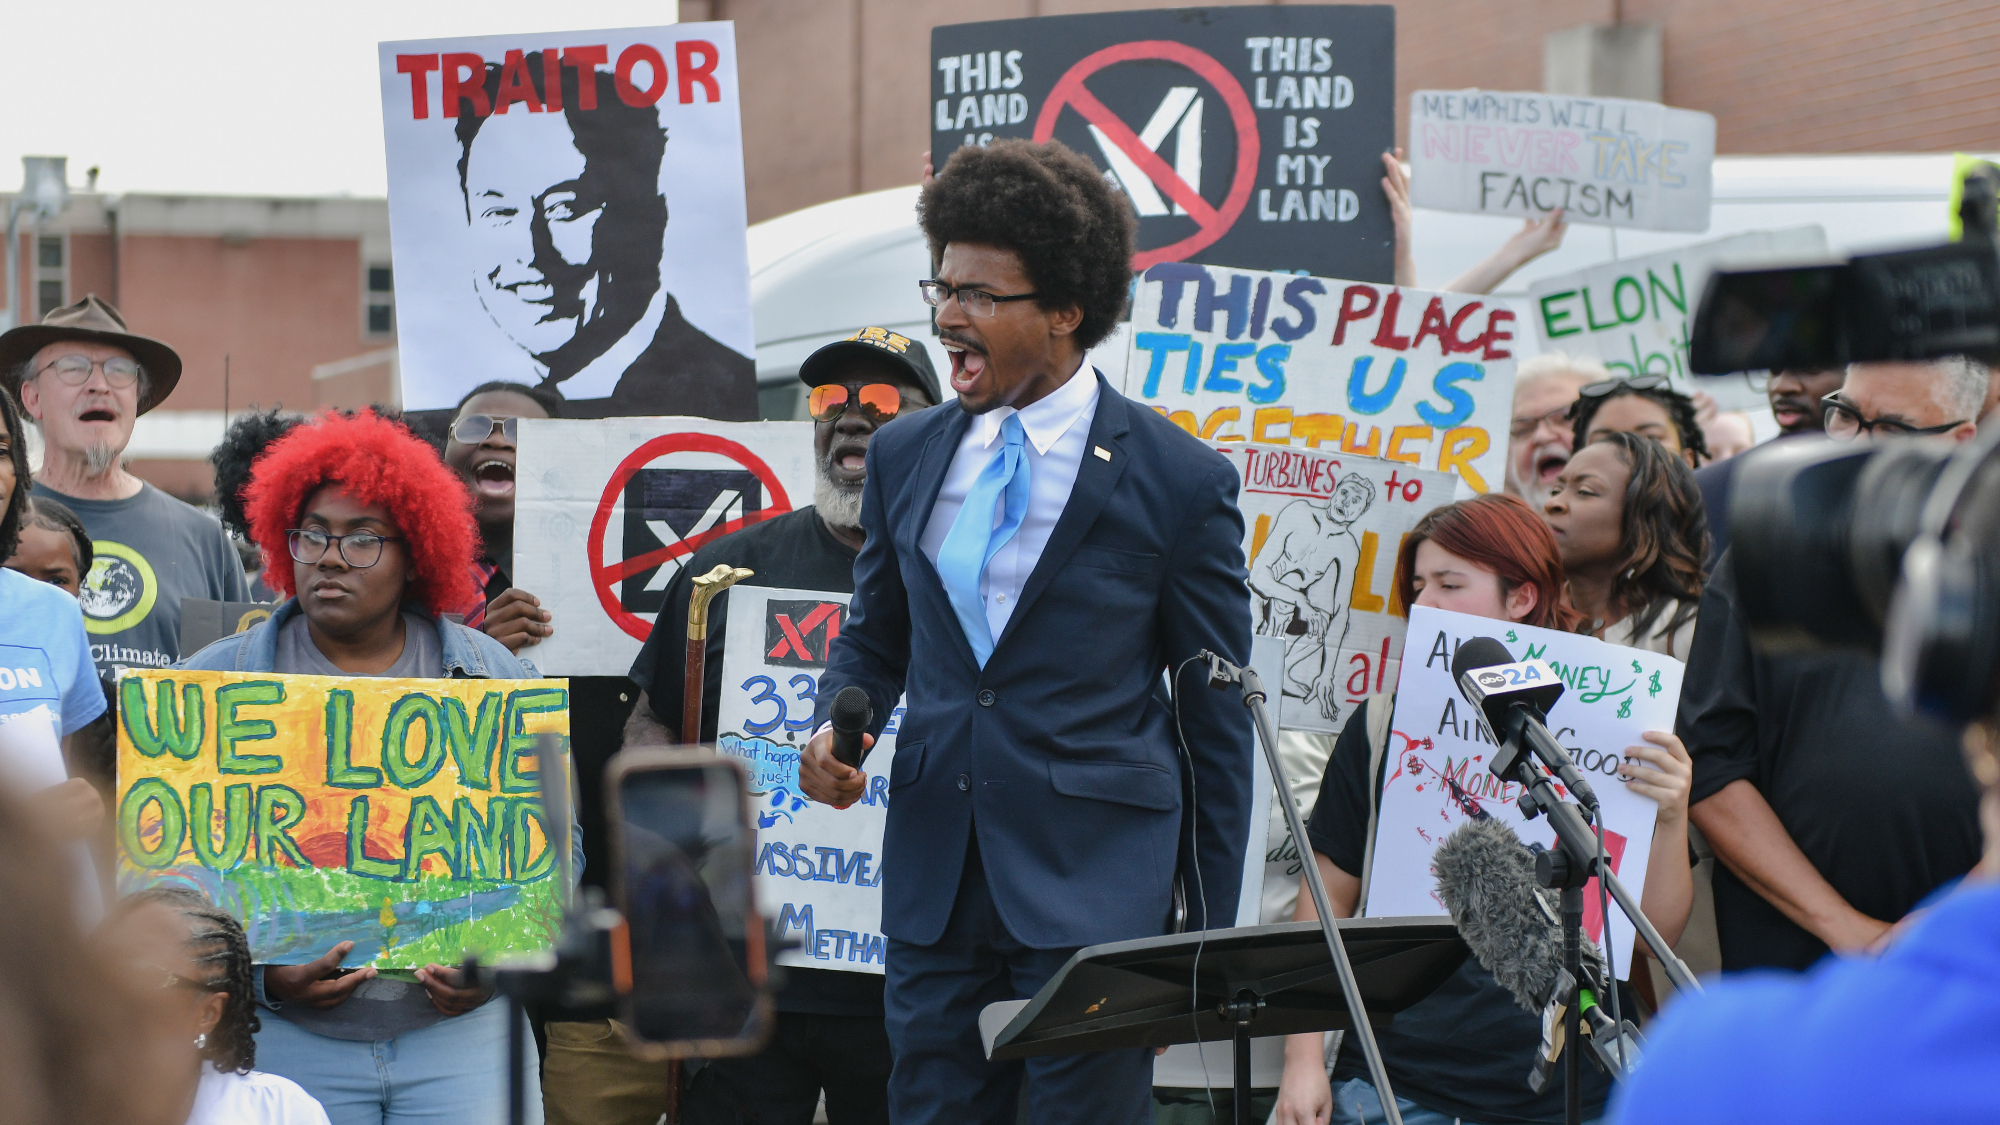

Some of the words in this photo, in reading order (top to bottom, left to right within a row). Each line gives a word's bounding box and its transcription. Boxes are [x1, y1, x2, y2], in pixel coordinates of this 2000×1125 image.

[937, 50, 1024, 94] THIS
[1245, 37, 1334, 73] THIS
[396, 39, 721, 119] TRAITOR
[1254, 76, 1356, 110] LAND
[935, 93, 1028, 131] LAND
[1283, 116, 1320, 149] IS
[1422, 95, 1541, 124] MEMPHIS
[1549, 100, 1639, 135] WILL
[1276, 154, 1333, 186] MY
[1421, 123, 1581, 173] NEVER
[1586, 131, 1689, 189] TAKE
[1258, 188, 1360, 223] LAND
[1480, 171, 1635, 220] FACISM
[1145, 262, 1327, 342] THIS
[1331, 284, 1516, 361] PLACE
[1540, 262, 1689, 338] ELON
[1135, 331, 1293, 403] TIES
[1347, 355, 1485, 430] US
[1244, 448, 1342, 494] TURBINES
[1385, 470, 1423, 503] to
[90, 643, 171, 669] Climate
[1502, 665, 1541, 686] 24
[119, 676, 286, 774] WE
[324, 688, 568, 793] LOVE
[721, 740, 760, 760] What
[758, 769, 791, 786] just
[119, 777, 312, 873] OUR
[346, 794, 560, 883] LAND
[752, 829, 872, 887] ASSIVE
